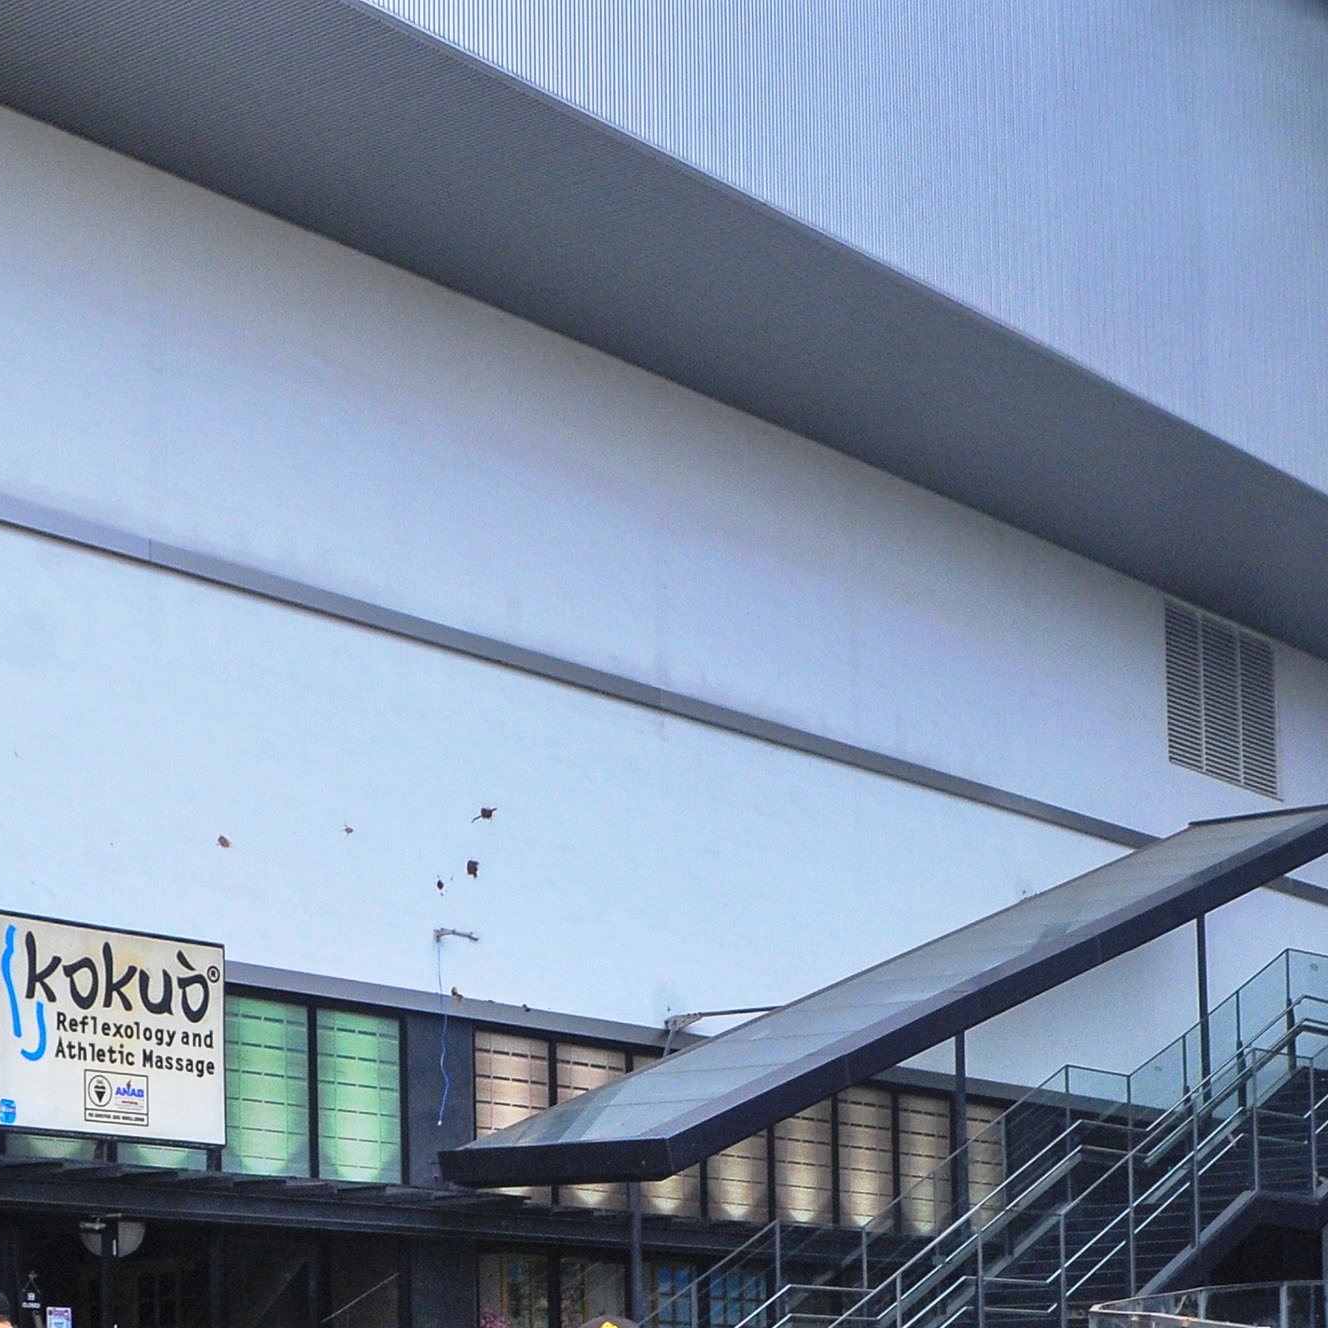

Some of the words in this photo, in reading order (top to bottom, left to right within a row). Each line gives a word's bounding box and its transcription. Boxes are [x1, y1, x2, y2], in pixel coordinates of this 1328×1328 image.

[56, 1011, 177, 1047] Reflexology
[181, 1030, 214, 1049] and
[54, 1036, 136, 1067] Athletic
[142, 1049, 216, 1079] Massage
